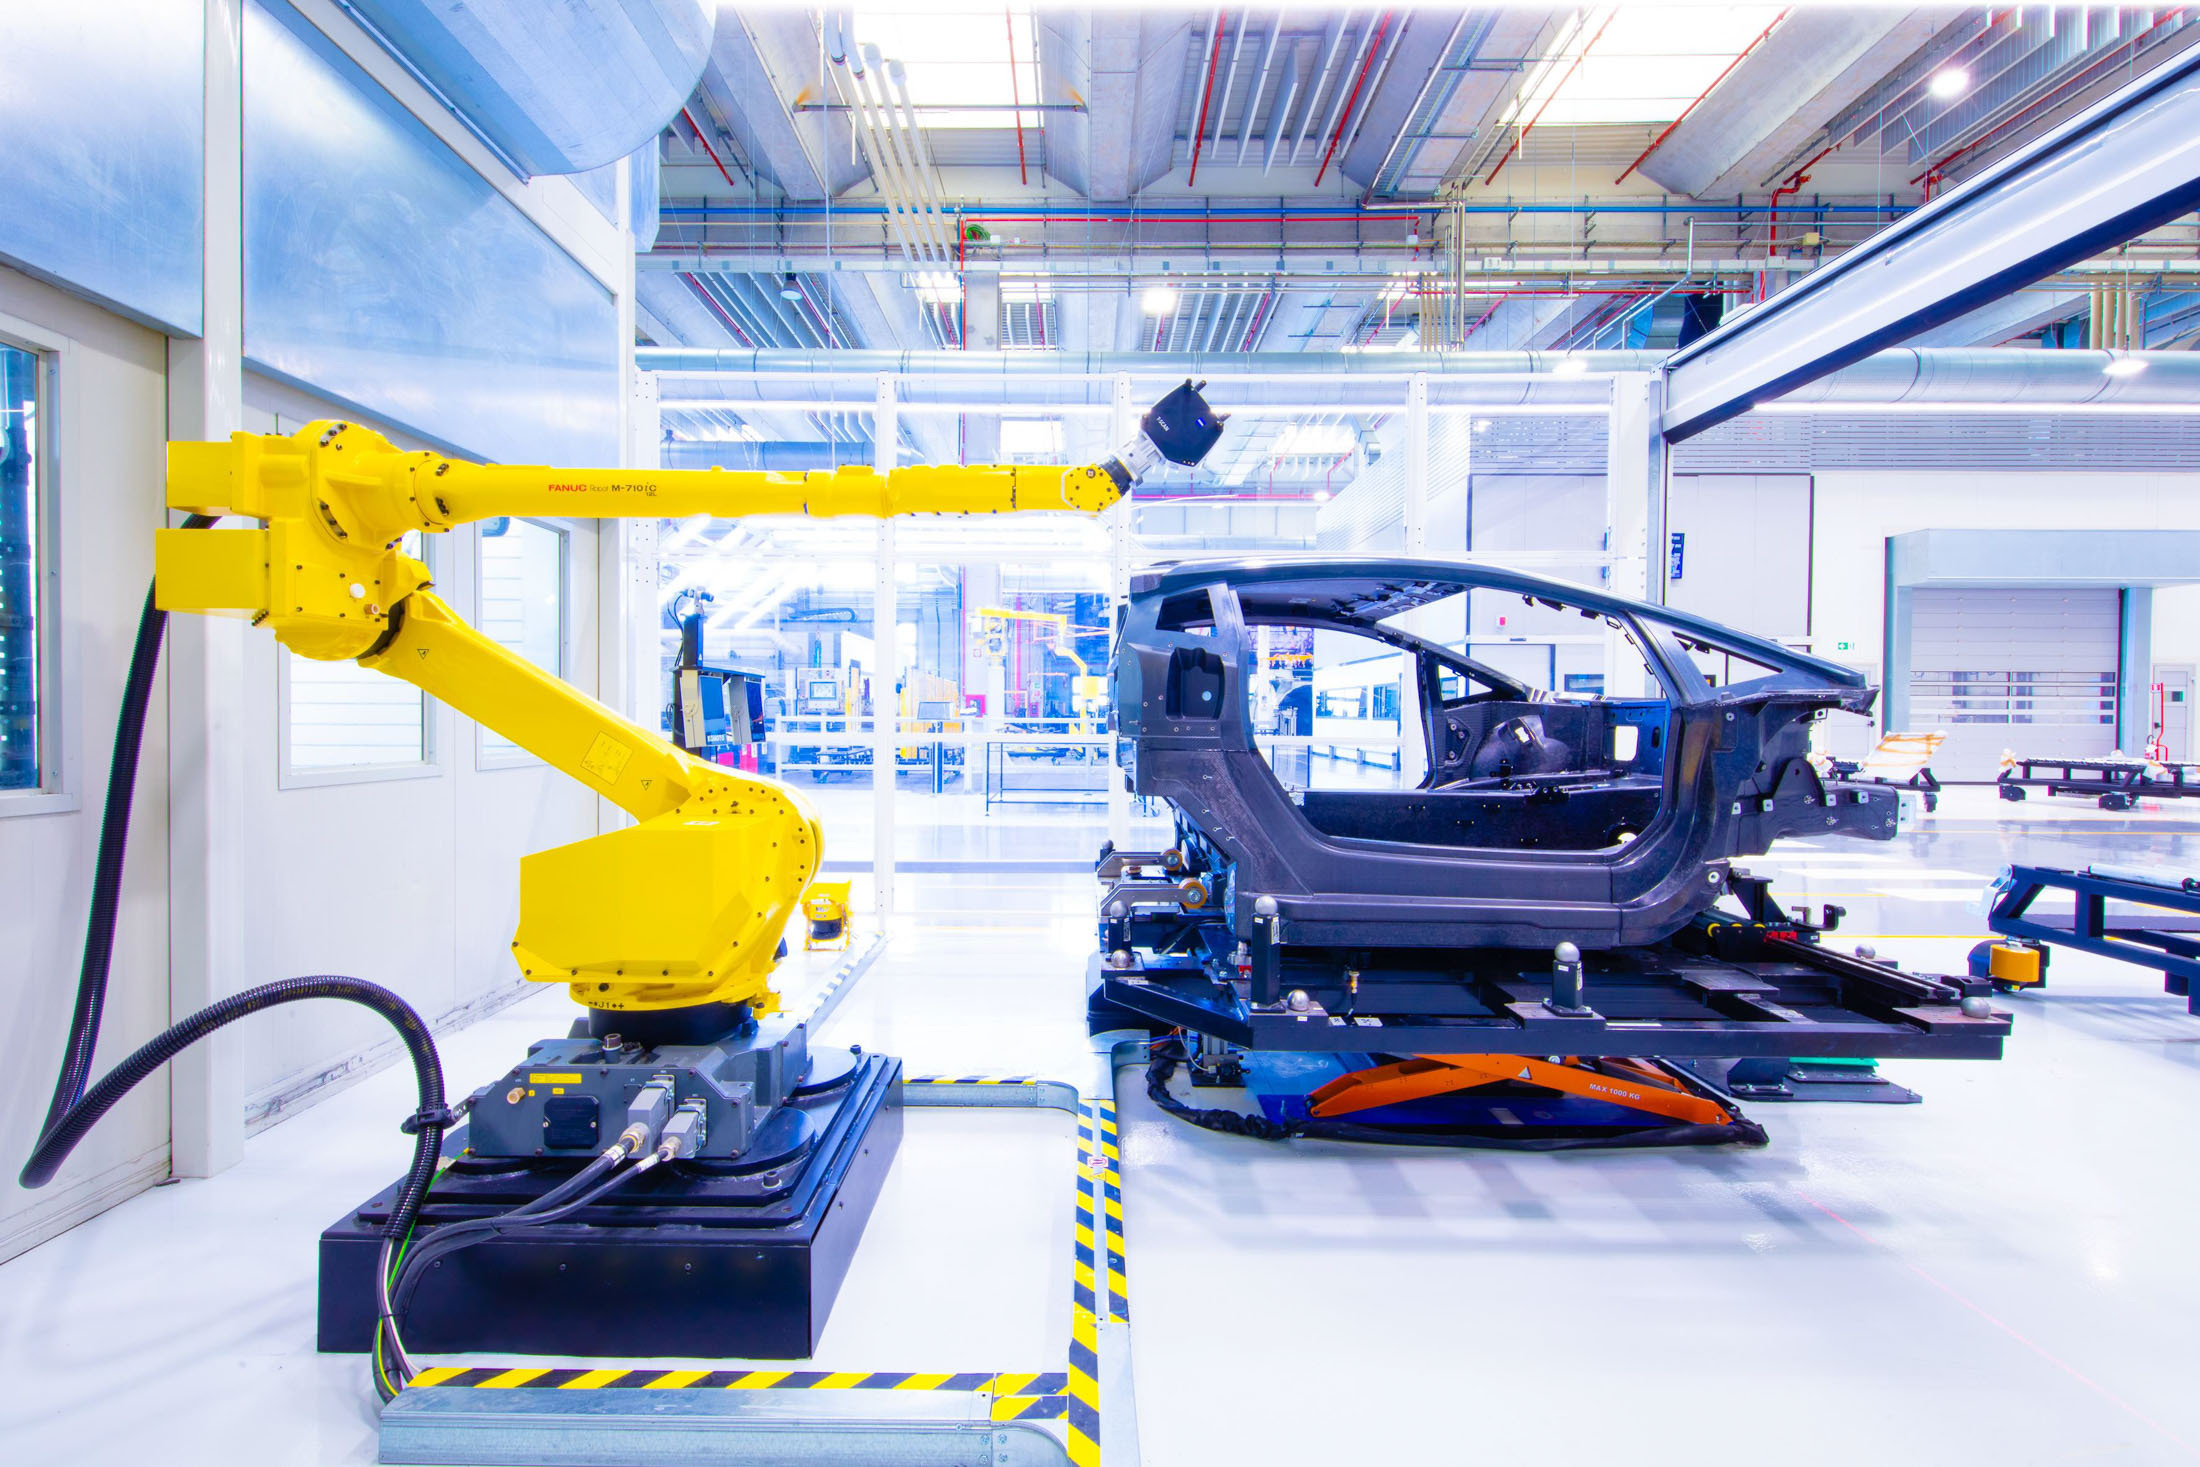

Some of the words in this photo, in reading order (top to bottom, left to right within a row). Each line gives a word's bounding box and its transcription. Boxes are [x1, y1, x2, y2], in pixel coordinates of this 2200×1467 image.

[548, 484, 587, 492] FANUC
[590, 484, 608, 492] Robot
[1589, 1083, 1607, 1093] MAX
[1609, 1088, 1627, 1097] 1000
[1629, 1092, 1641, 1101] KG
